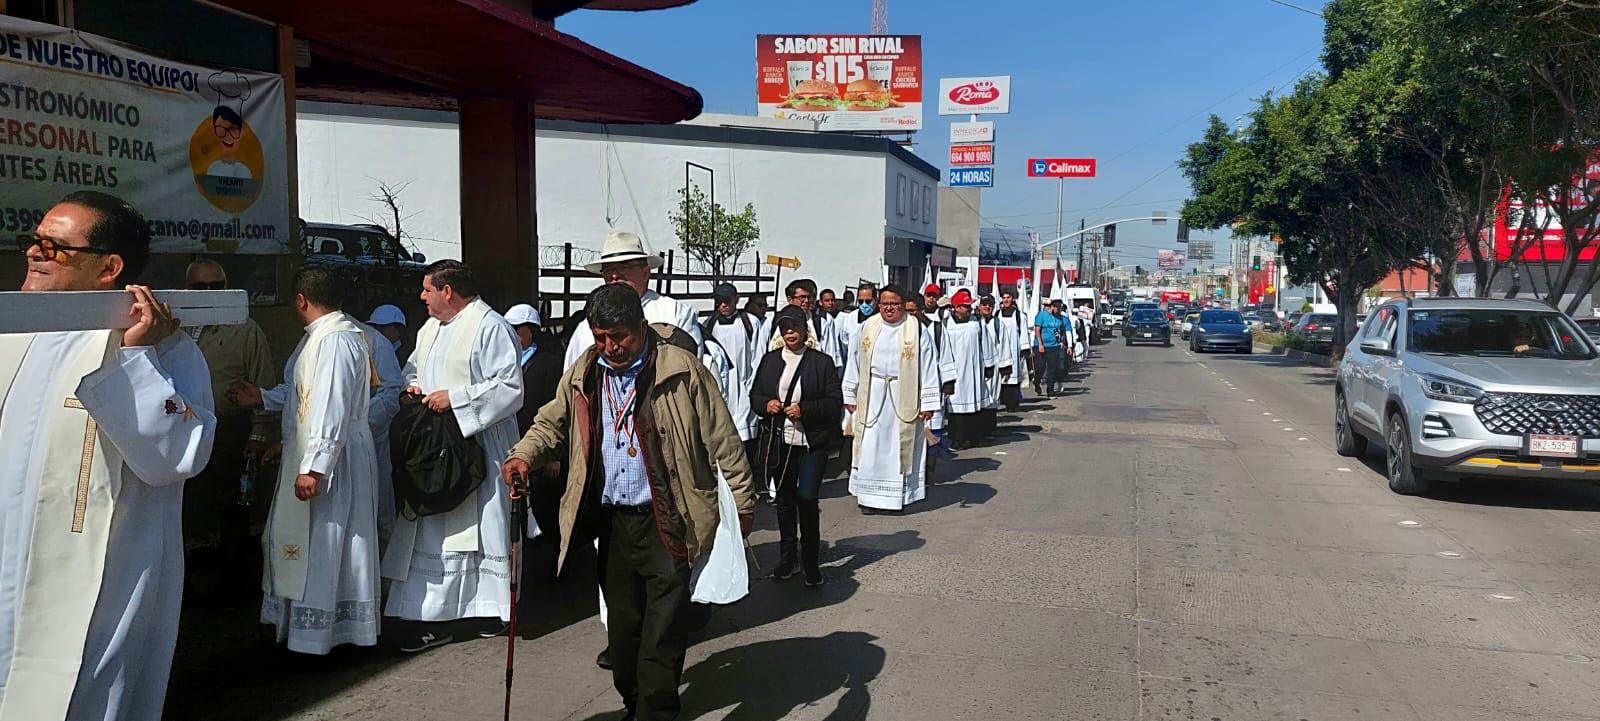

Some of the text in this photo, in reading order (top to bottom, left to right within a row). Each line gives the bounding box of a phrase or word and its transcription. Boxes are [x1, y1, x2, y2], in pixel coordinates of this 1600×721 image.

[0, 33, 22, 59] DE
[26, 37, 124, 78] NUESTRO
[775, 37, 905, 54] SABOR SIN RIVAL
[815, 55, 865, 84] $115
[0, 82, 140, 127] STRONÓMICO
[956, 87, 992, 102] Roma
[108, 135, 157, 163] PARA
[963, 152, 975, 163] 900
[976, 151, 991, 162] 9090
[52, 156, 118, 188] ÁREAS
[950, 170, 990, 184] 24 HORAS
[1048, 162, 1091, 174] Calimax
